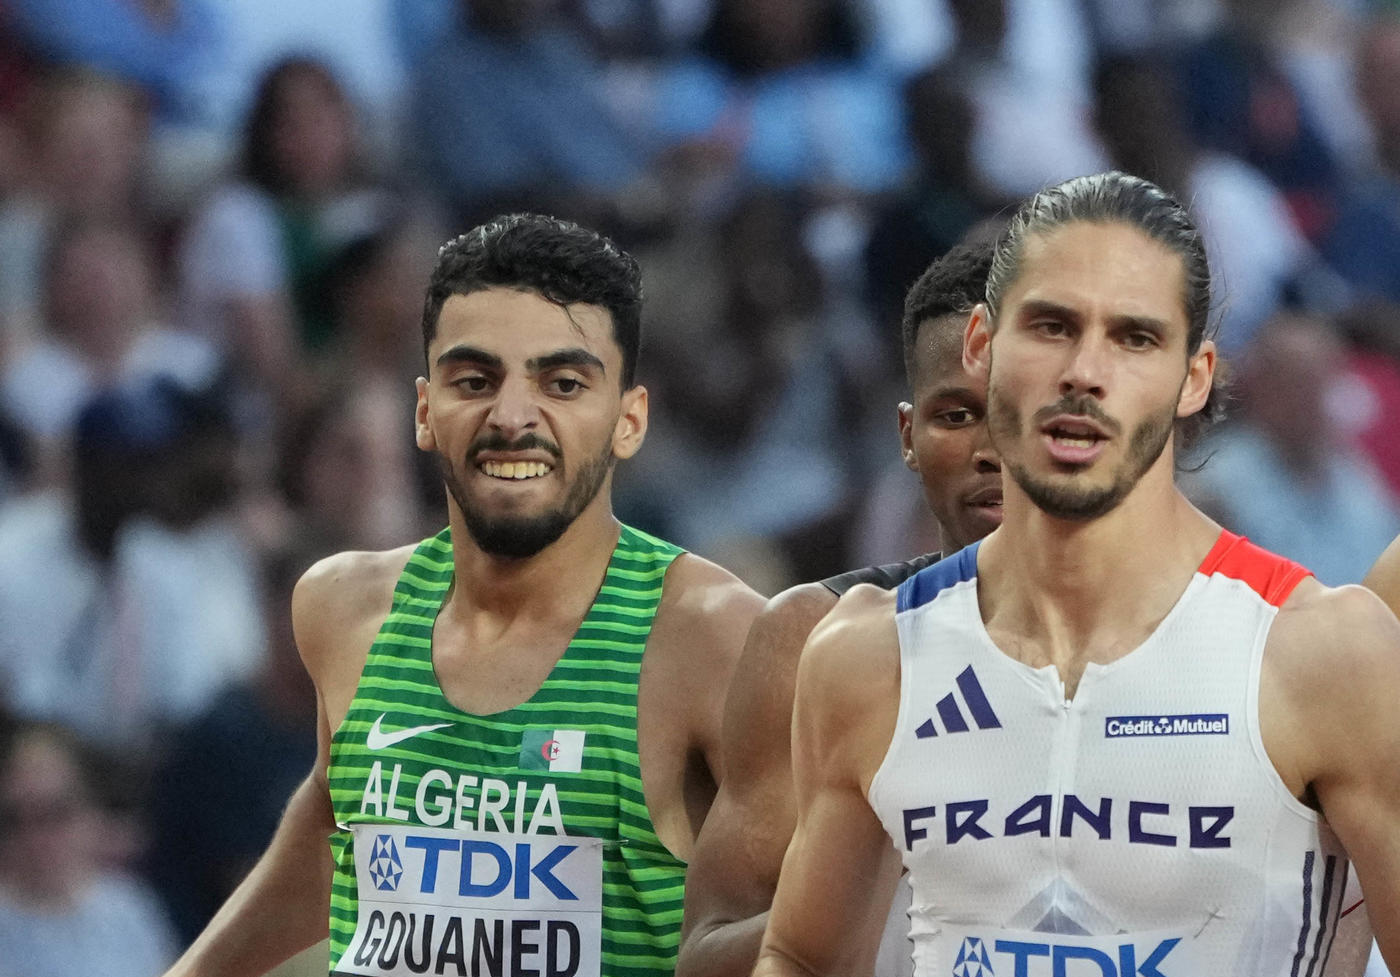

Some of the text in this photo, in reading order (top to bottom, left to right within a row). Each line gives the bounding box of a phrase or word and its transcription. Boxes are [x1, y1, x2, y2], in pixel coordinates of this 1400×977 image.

[1107, 717, 1227, 736] Crédit Mutuel
[360, 761, 567, 836] ALGERIA
[903, 794, 1235, 852] FRANCE
[405, 836, 580, 900] TDK
